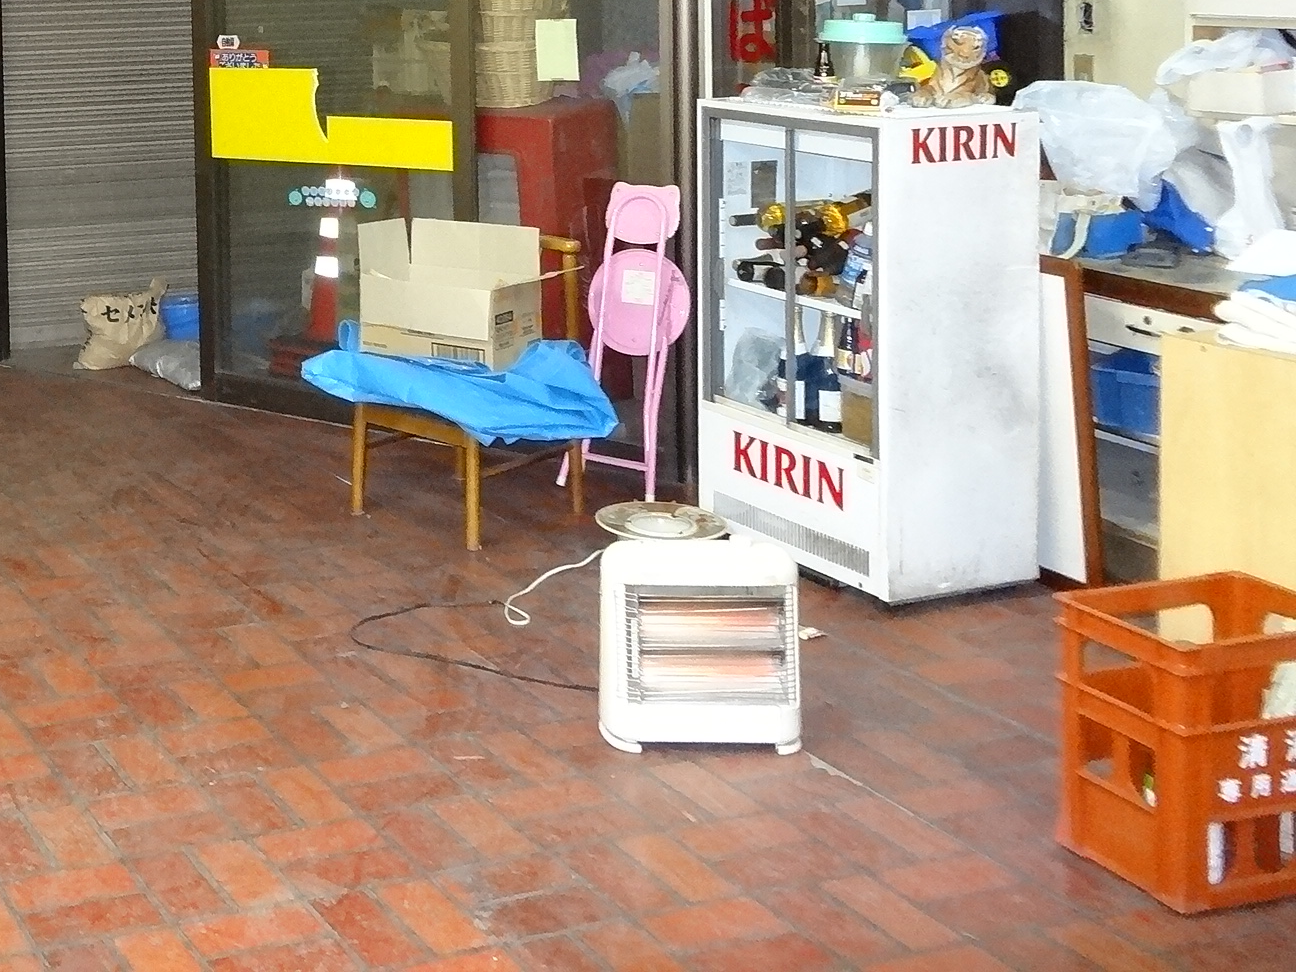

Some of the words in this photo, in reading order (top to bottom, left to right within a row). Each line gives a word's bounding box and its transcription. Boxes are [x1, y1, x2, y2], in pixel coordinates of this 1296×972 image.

[221, 53, 257, 63] ありがとう
[911, 123, 1017, 164] KIRIN
[733, 430, 844, 512] KIRIN
